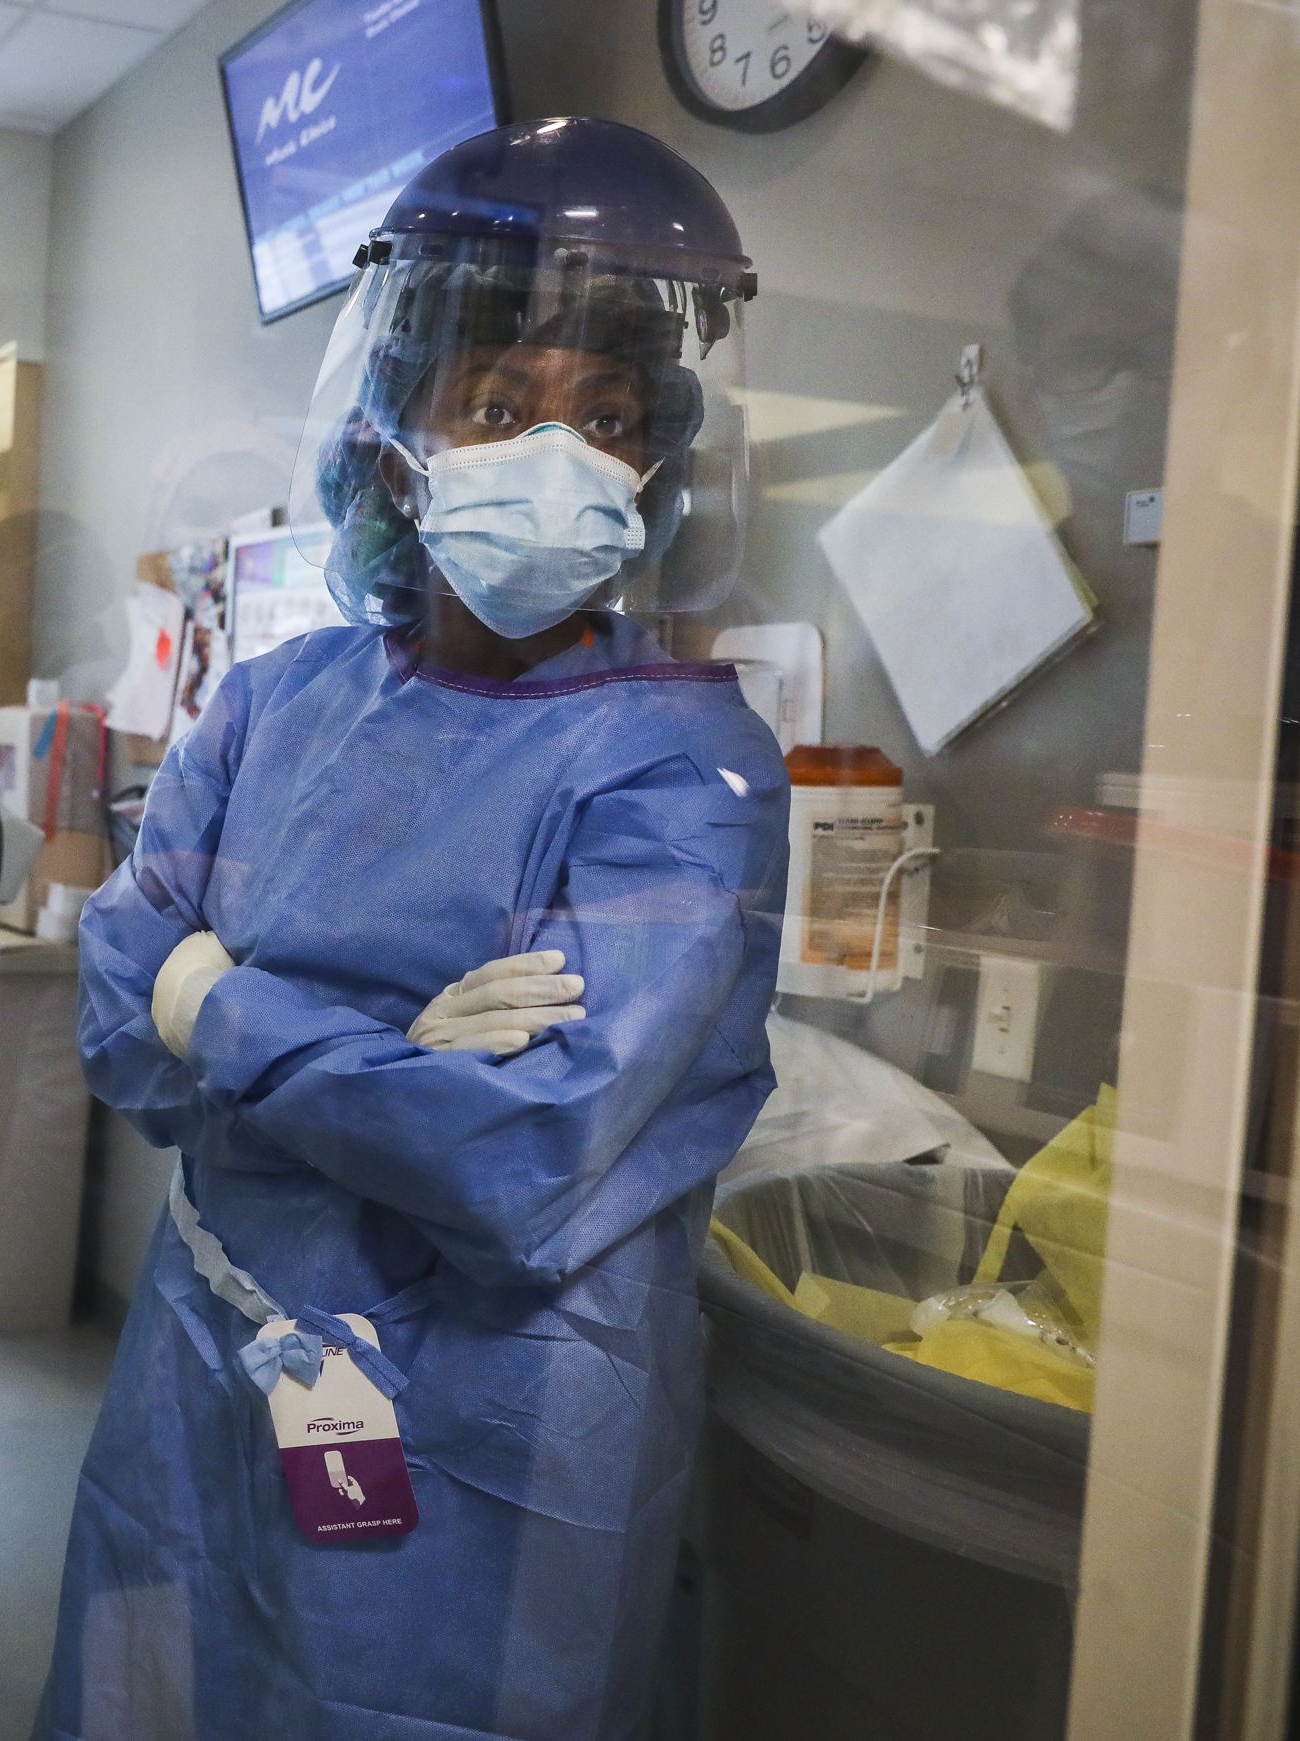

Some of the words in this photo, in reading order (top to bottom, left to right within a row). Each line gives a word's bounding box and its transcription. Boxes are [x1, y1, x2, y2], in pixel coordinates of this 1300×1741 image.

[709, 32, 726, 68] 8
[770, 44, 792, 80] 6
[735, 51, 752, 87] 7
[307, 1420, 364, 1433] Proxima
[317, 1521, 354, 1532] ASSISTANT
[357, 1520, 381, 1528] GRASP
